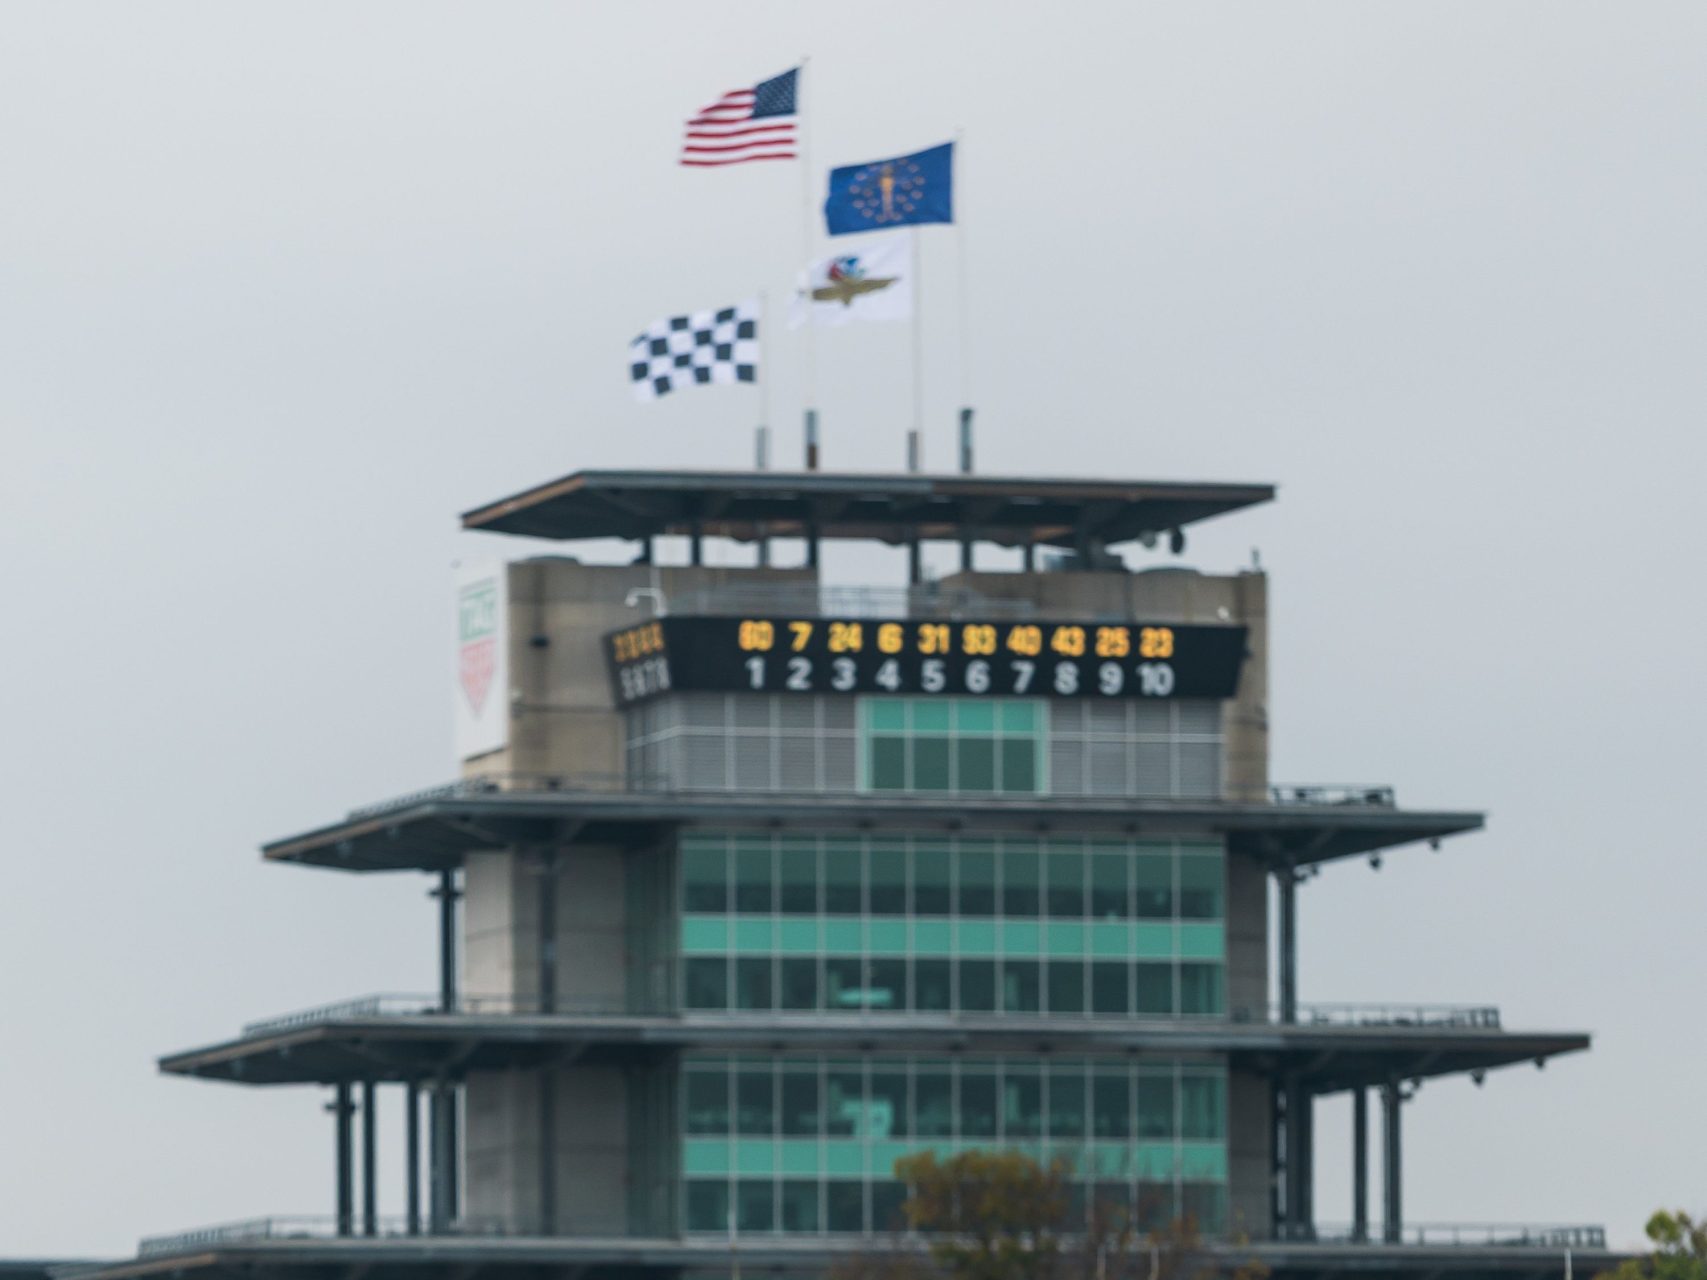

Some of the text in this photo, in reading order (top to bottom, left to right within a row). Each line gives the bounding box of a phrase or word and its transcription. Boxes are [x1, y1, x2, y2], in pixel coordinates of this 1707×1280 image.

[789, 622, 813, 650] 7
[829, 624, 863, 652] 24
[919, 624, 949, 654] 31
[746, 657, 1174, 695] 1 2 3 4 5 6 7 8 9 10
